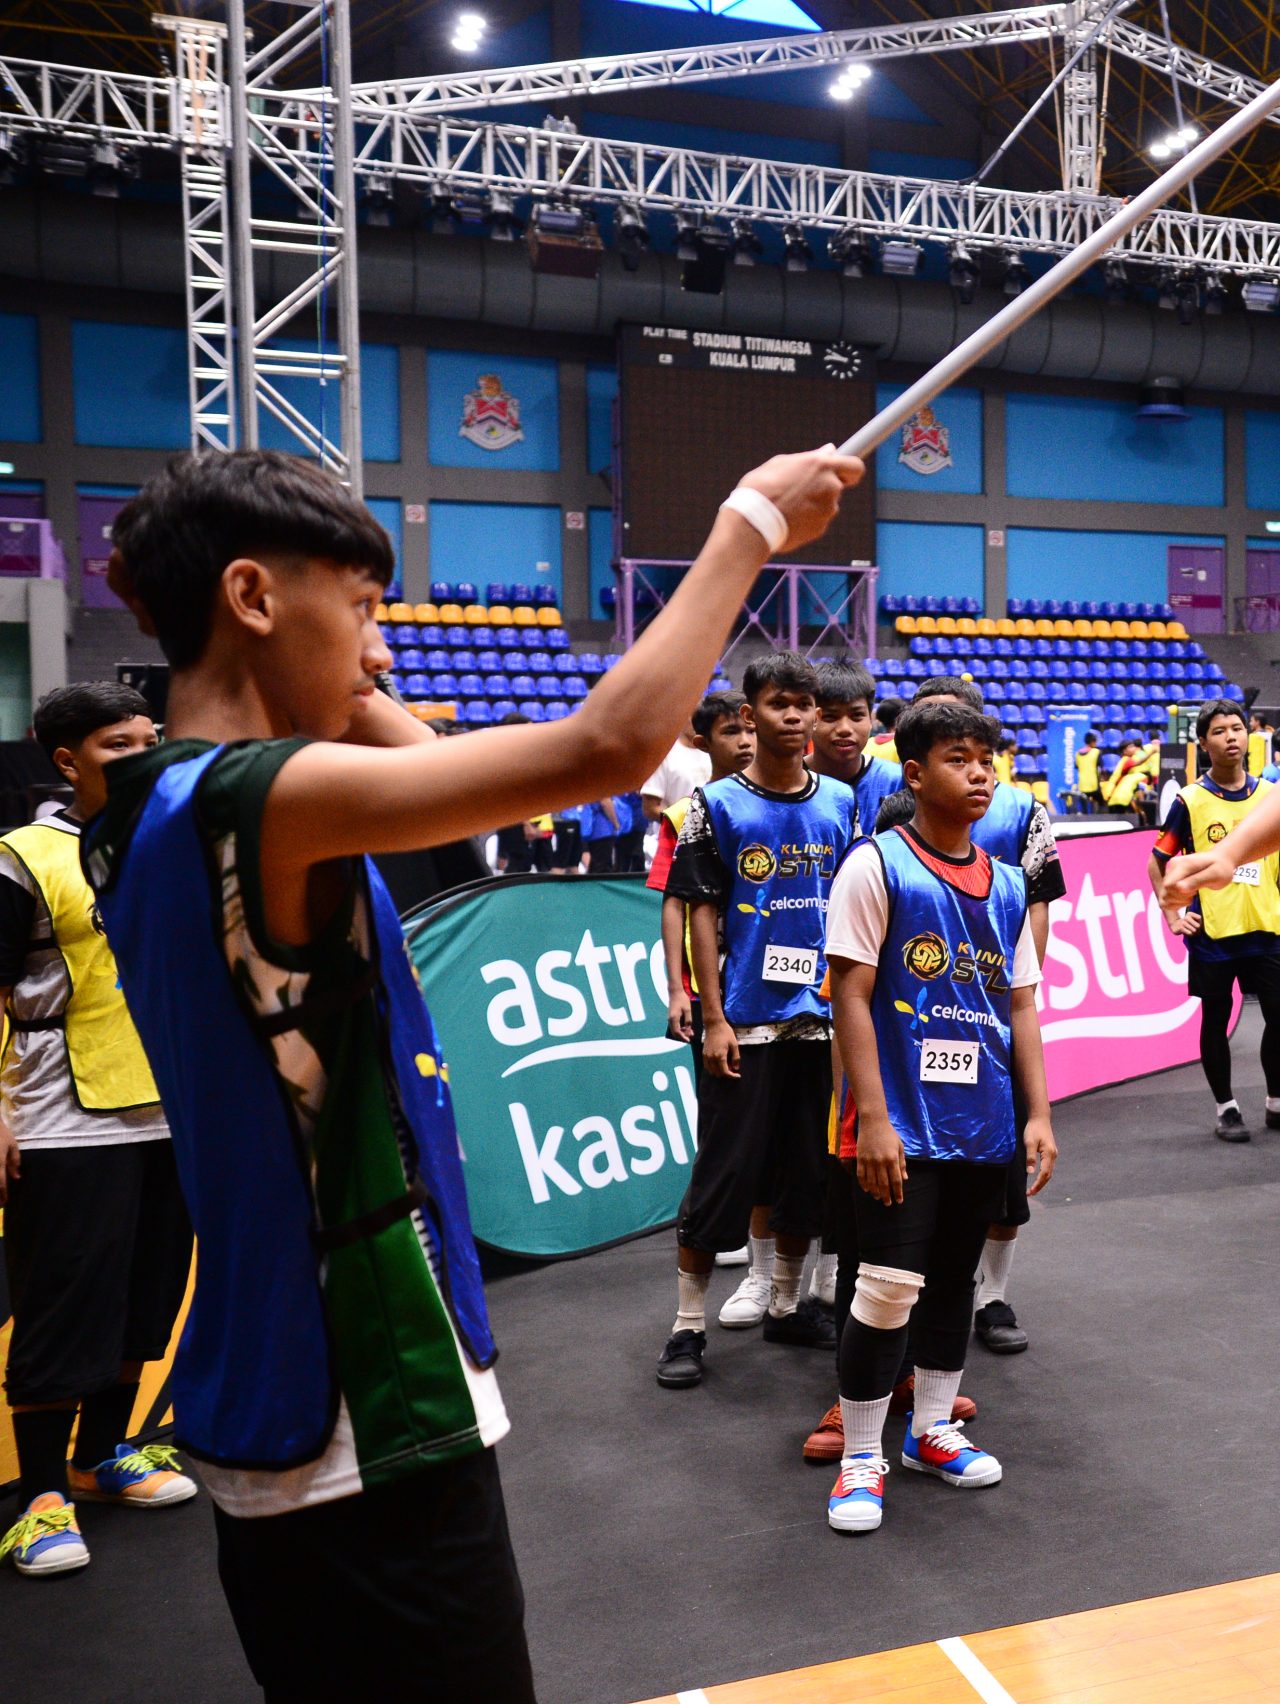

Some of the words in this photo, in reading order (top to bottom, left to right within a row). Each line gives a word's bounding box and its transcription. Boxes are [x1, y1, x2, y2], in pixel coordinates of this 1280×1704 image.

[643, 326, 665, 337] PLAY
[667, 328, 688, 340] TIME
[692, 332, 742, 349] STADIUM
[744, 336, 812, 355] TITIWANGSA
[709, 352, 748, 368] KUALA
[751, 355, 796, 372] LUMPUR
[781, 843, 833, 855] KLINIK
[778, 855, 833, 879] STL
[1036, 872, 1188, 1012] stro
[767, 955, 812, 974] 2340
[950, 956, 1008, 995] STL
[925, 1051, 973, 1071] 2359
